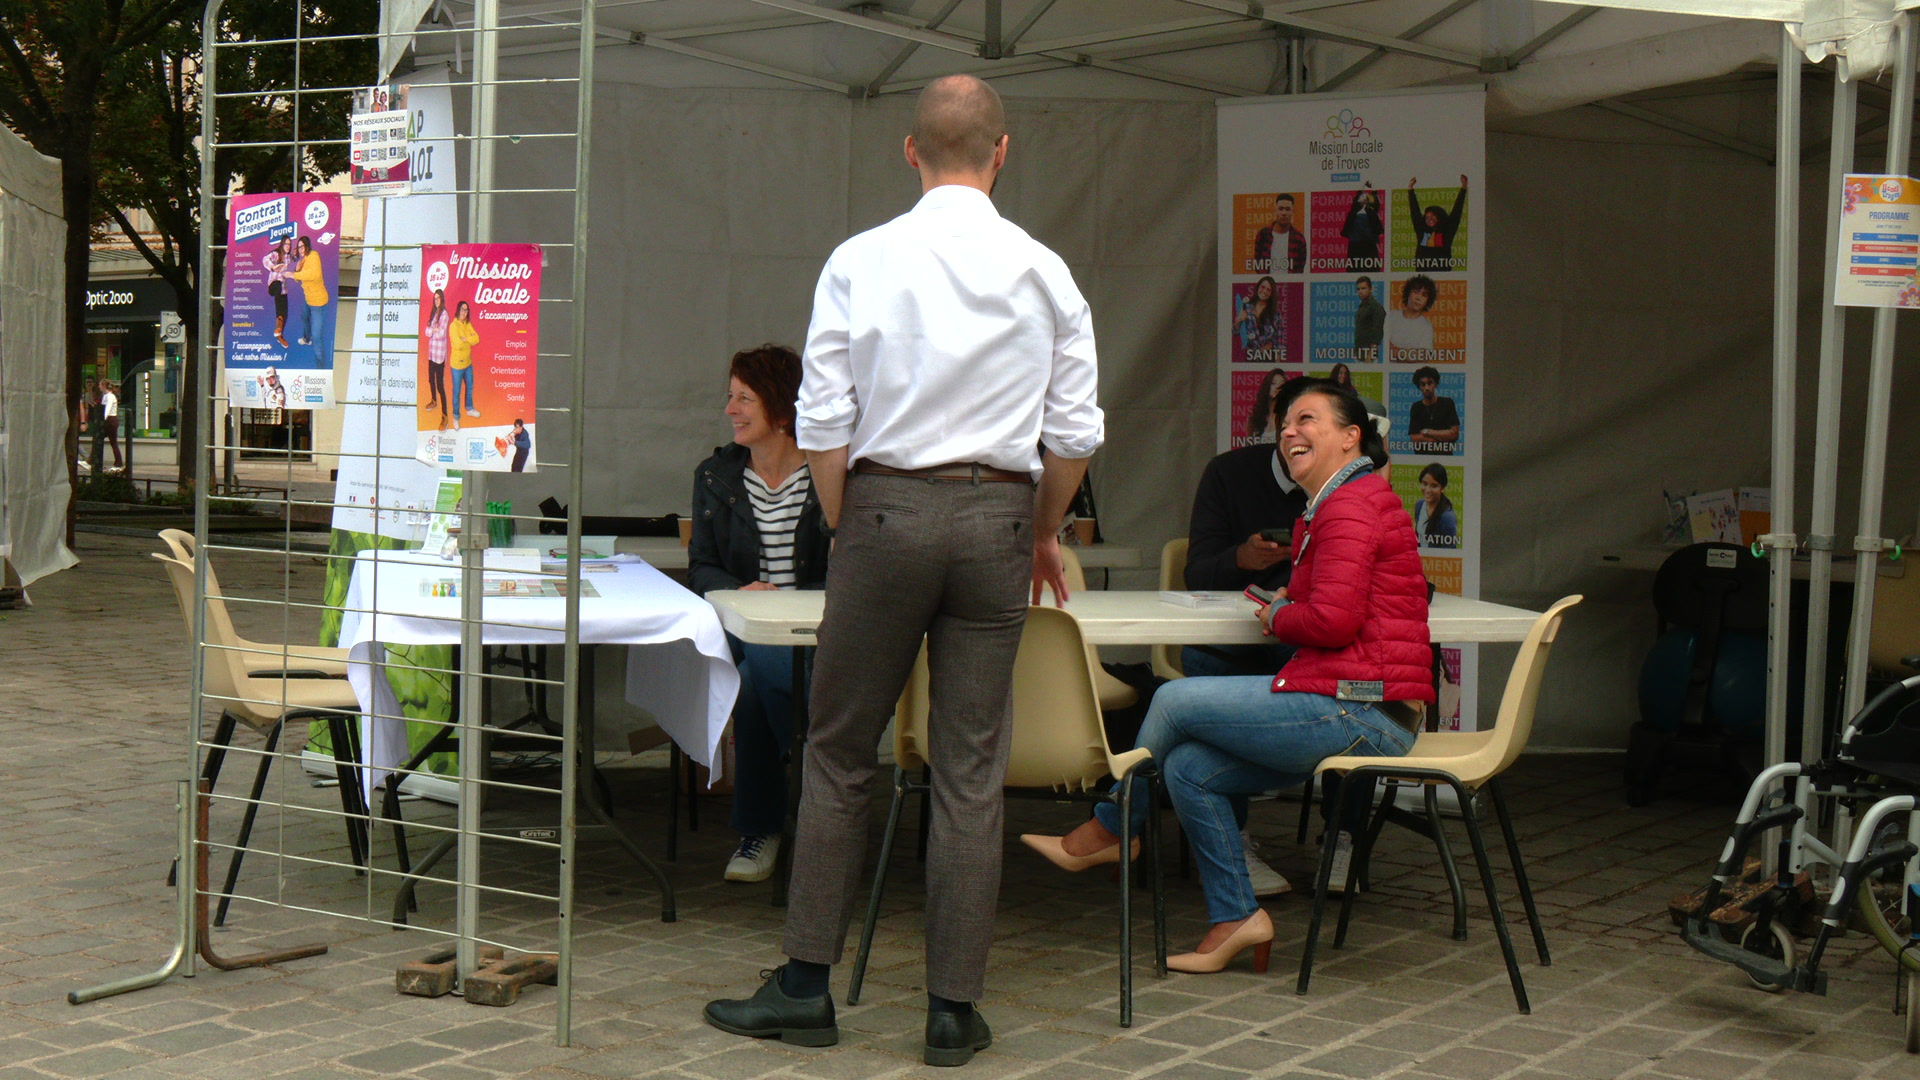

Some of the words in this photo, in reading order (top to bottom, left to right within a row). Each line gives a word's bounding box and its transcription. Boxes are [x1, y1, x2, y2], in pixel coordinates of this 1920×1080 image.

[407, 109, 424, 143] AP
[1309, 141, 1348, 155] Mission
[1351, 139, 1383, 153] Locale
[1321, 157, 1333, 171] de
[237, 201, 282, 225] Contrat
[1869, 211, 1910, 221] PROGRAMME
[237, 215, 282, 235] d'Engagement
[270, 225, 293, 240] Jeune
[449, 249, 459, 264] la
[1311, 257, 1383, 269] FORMATION
[1392, 257, 1466, 269] ORIENTATION
[456, 256, 532, 279] Mission
[1245, 257, 1294, 271] EMPLOI
[109, 290, 133, 305] 2000
[474, 282, 531, 304] locale
[384, 311, 399, 321] côté
[479, 309, 529, 323] t'accompagne
[506, 340, 527, 349] Emploi
[260, 352, 283, 361] Mission
[494, 353, 526, 361] Formation
[1315, 344, 1378, 360] MOBILITÉ
[1390, 348, 1465, 361] LOGEMENT
[490, 367, 526, 375] Orientation
[304, 376, 326, 385] Missions
[494, 381, 525, 389] Logement
[507, 393, 525, 402] Santé
[1390, 441, 1464, 452] RECRUTEMENT
[1417, 534, 1461, 545] NTATION
